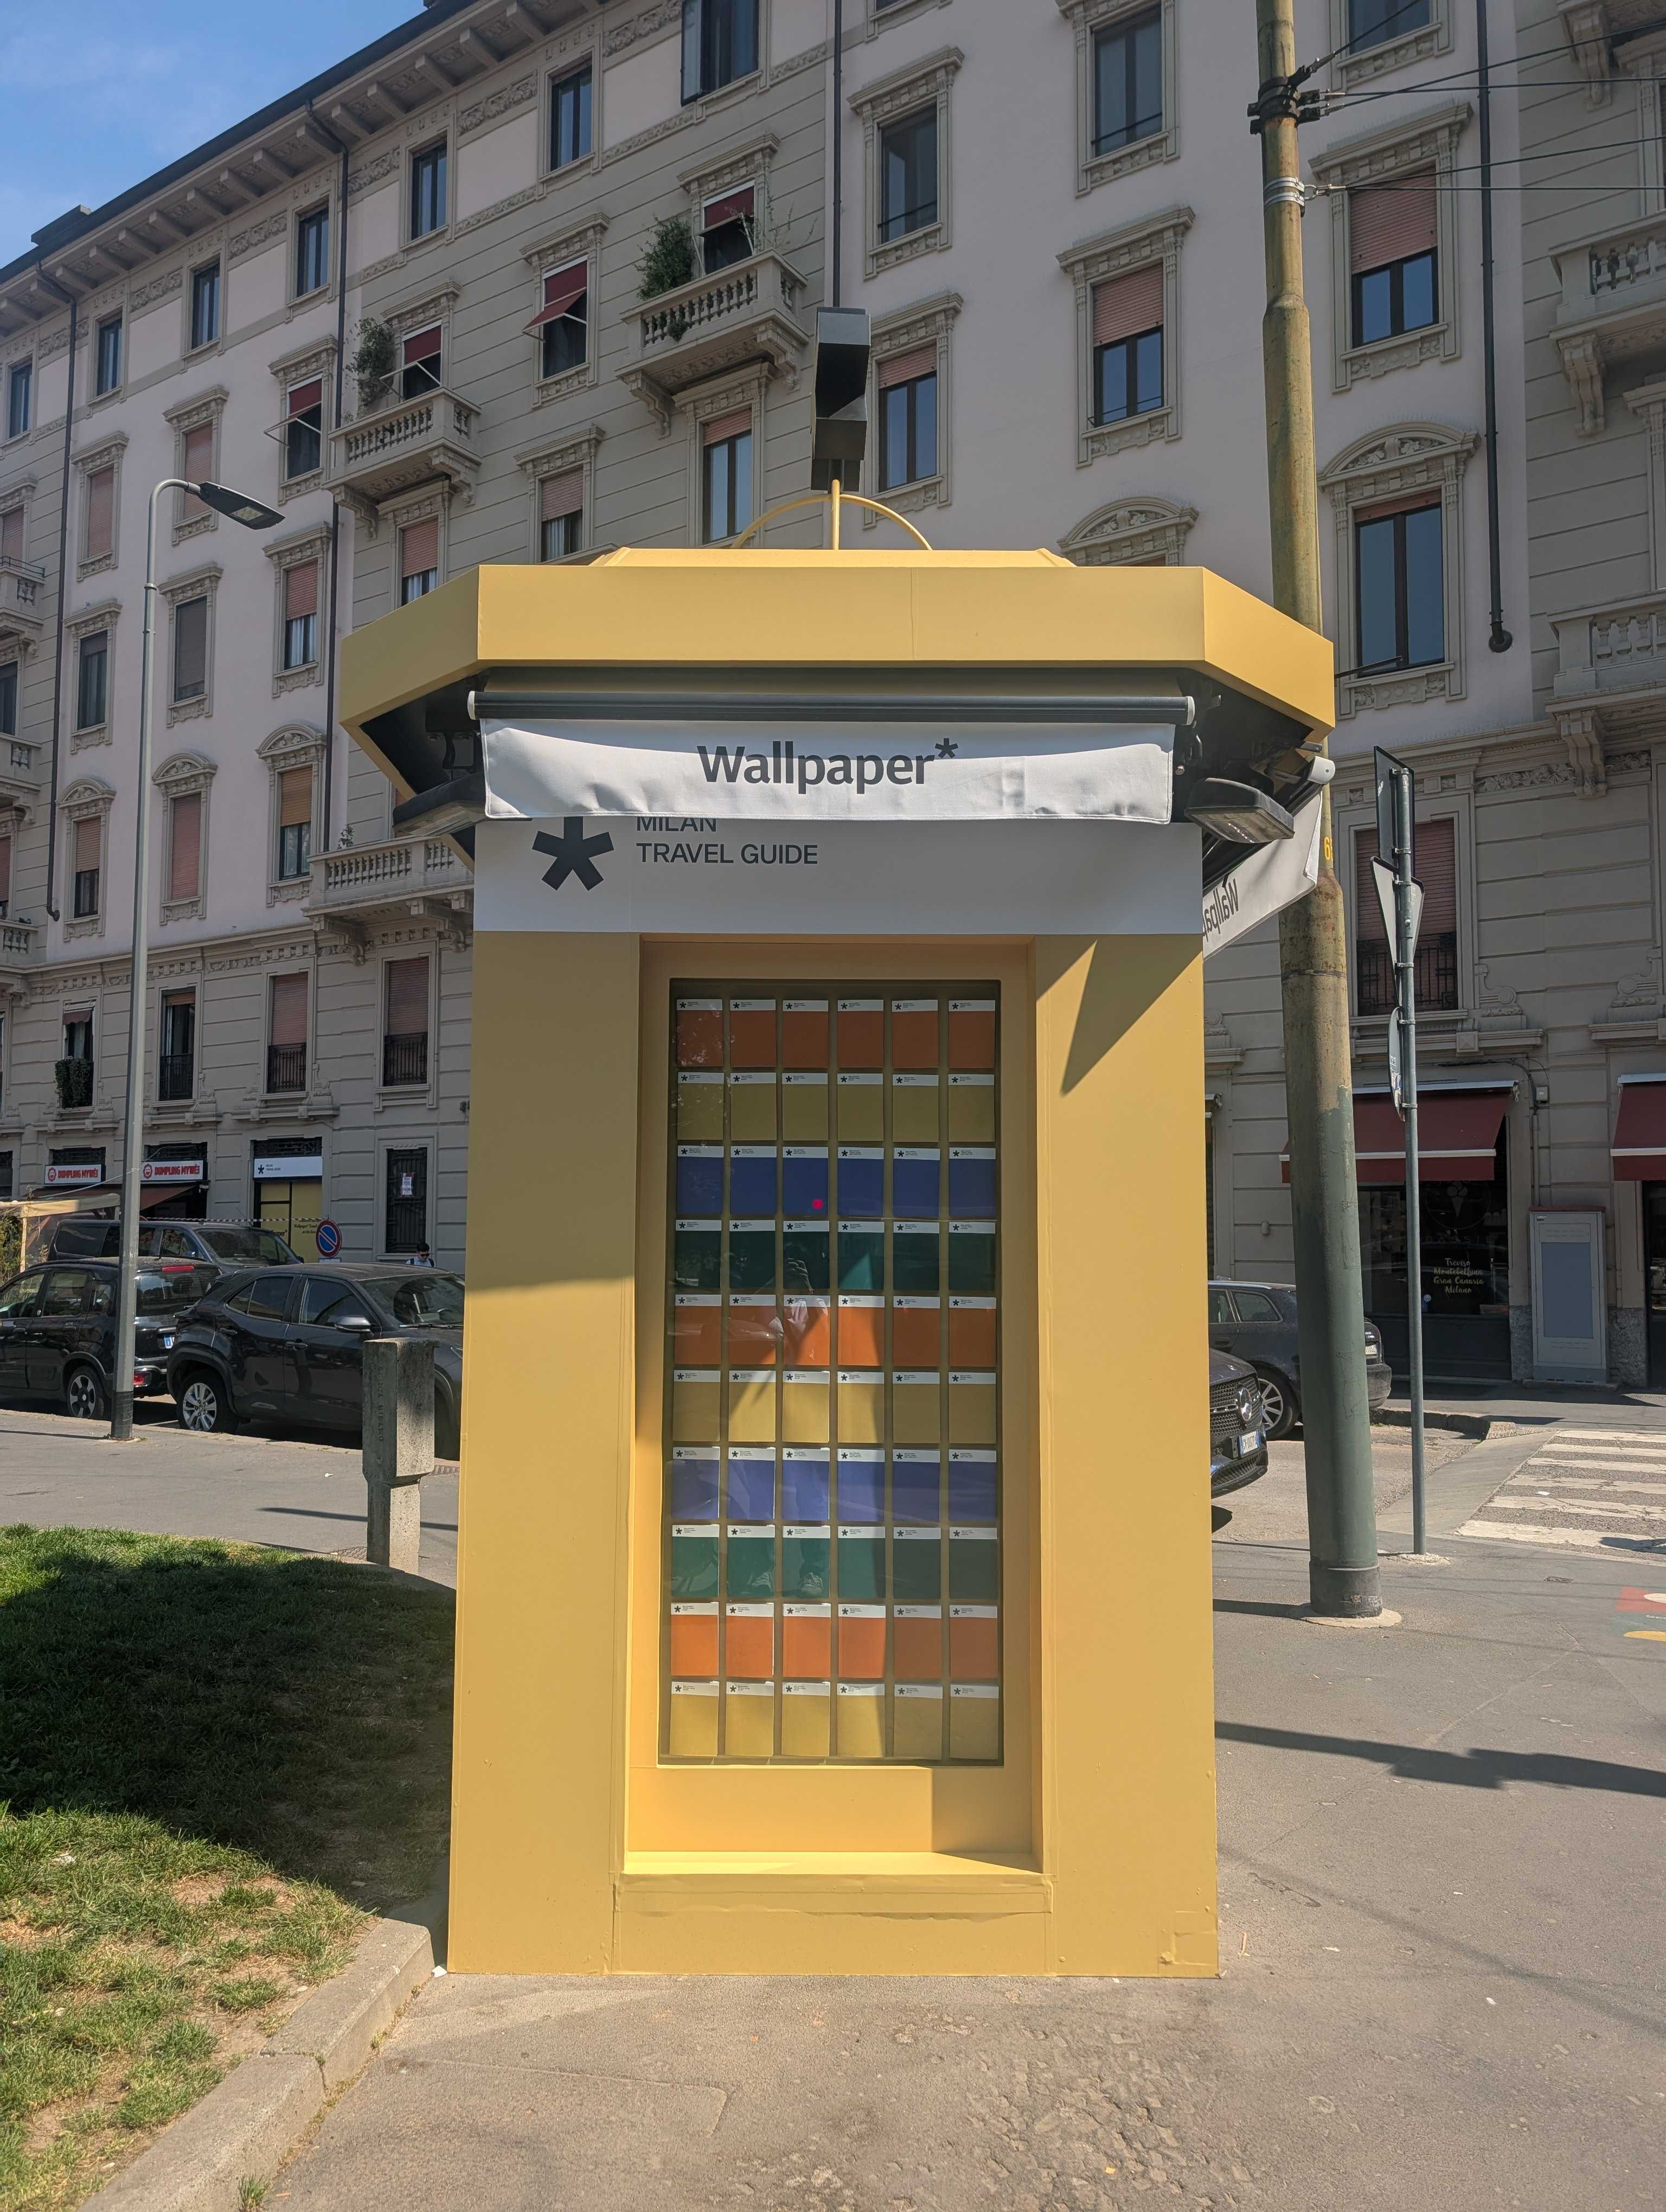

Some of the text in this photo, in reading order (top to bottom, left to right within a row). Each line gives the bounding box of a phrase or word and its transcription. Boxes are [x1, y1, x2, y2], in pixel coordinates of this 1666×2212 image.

[636, 817, 716, 832] MILAN
[636, 843, 818, 864] TRAVEL GUIDE
[1445, 1257, 1470, 1266] Treviso
[1433, 1276, 1484, 1284] Gran Canaria
[1445, 1285, 1472, 1294] Milano
